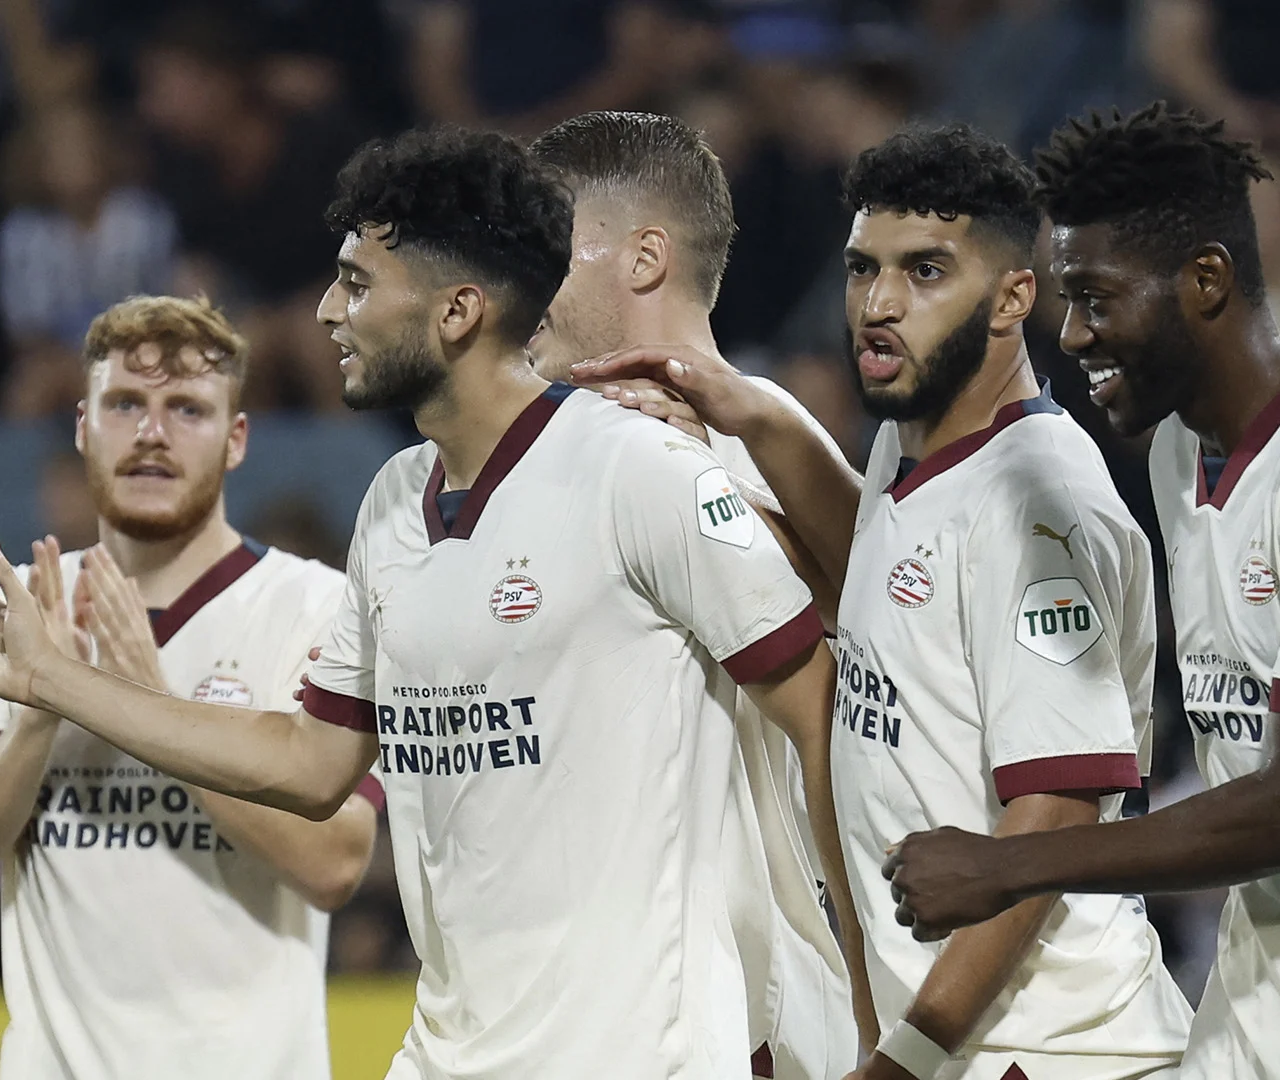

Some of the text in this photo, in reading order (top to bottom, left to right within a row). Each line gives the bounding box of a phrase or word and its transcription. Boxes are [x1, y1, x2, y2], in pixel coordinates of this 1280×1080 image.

[702, 493, 746, 527] TOTO
[900, 573, 917, 587] PSV
[1249, 573, 1262, 584] PSV
[503, 591, 523, 602] PSV
[1024, 605, 1090, 637] TOTO
[378, 696, 536, 737] RAINPORT
[380, 735, 541, 775] INDHOVEN
[36, 785, 201, 814] RAINPO
